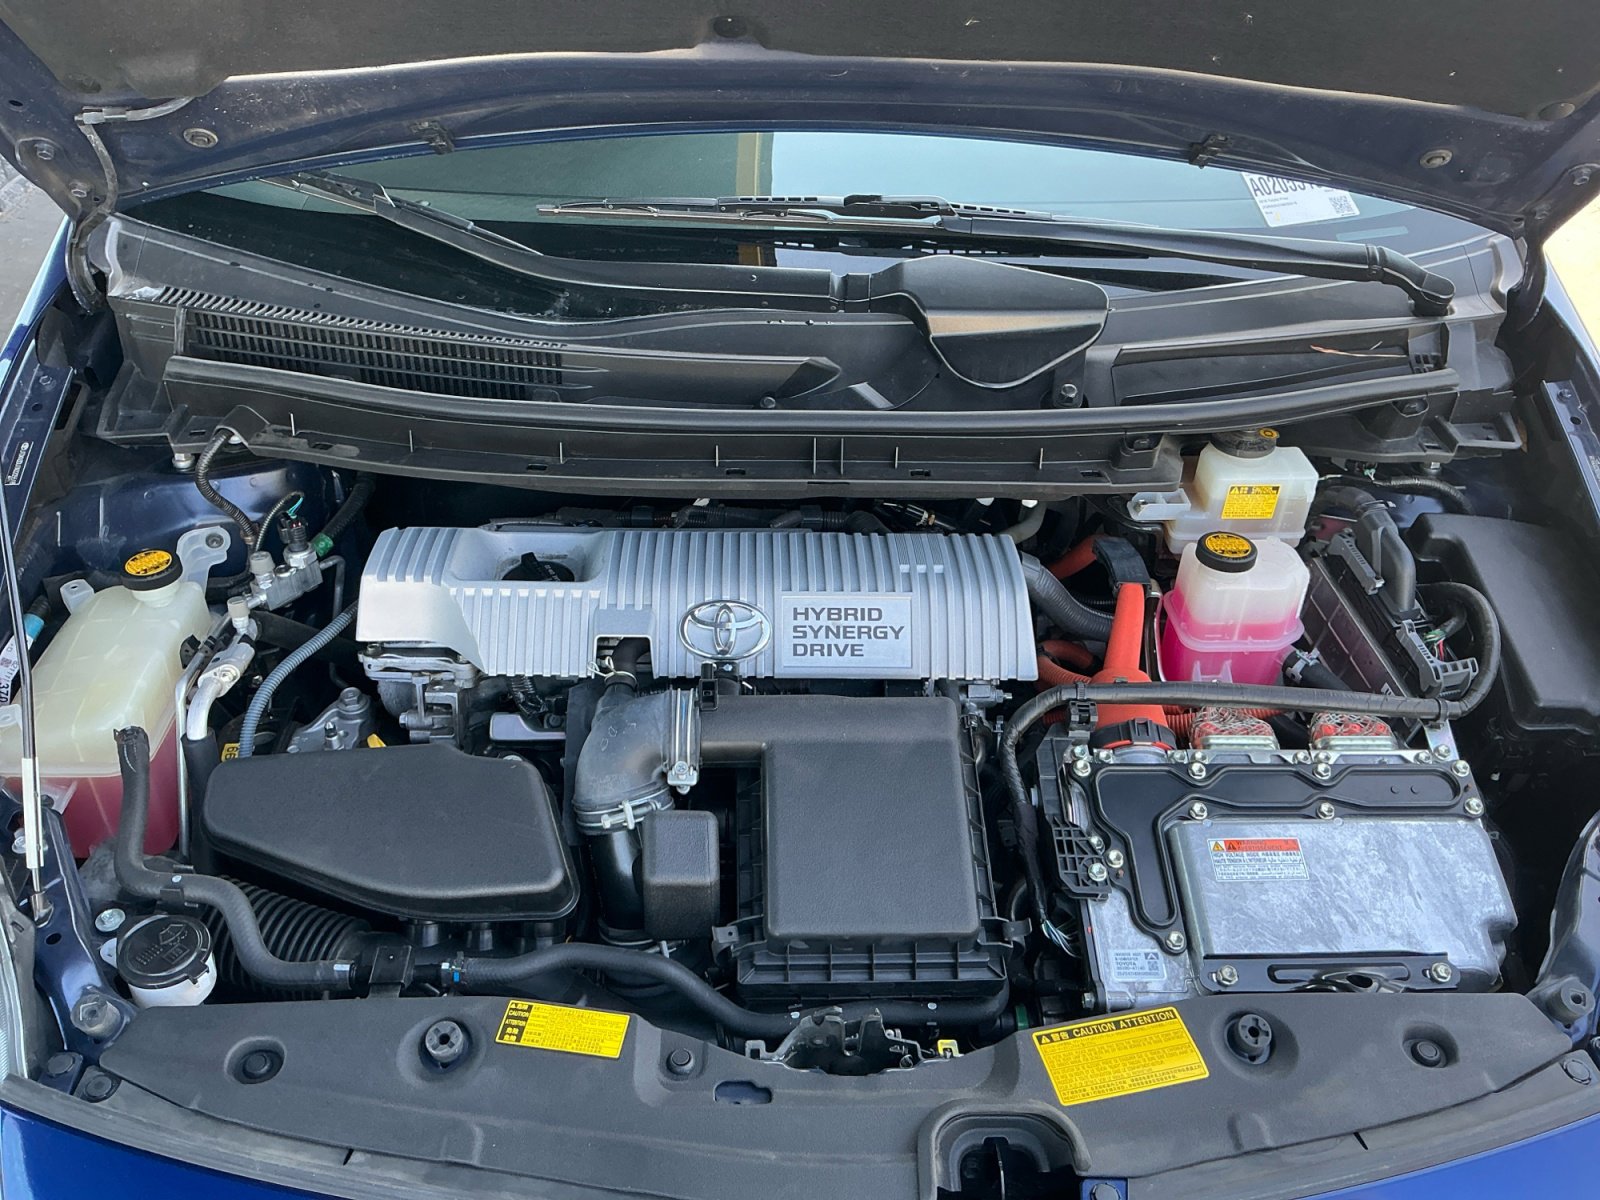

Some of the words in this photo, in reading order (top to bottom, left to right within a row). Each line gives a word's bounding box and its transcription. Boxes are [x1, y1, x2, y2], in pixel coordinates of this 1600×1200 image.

[793, 607, 883, 621] HYBRID
[793, 625, 905, 640] SYNERGY
[793, 643, 864, 657] DRIVE
[508, 1010, 529, 1018] CAUTION
[505, 1019, 526, 1027] ATTENTION
[1072, 1022, 1116, 1038] CAUTION
[1119, 1011, 1175, 1029] ATTENTION
